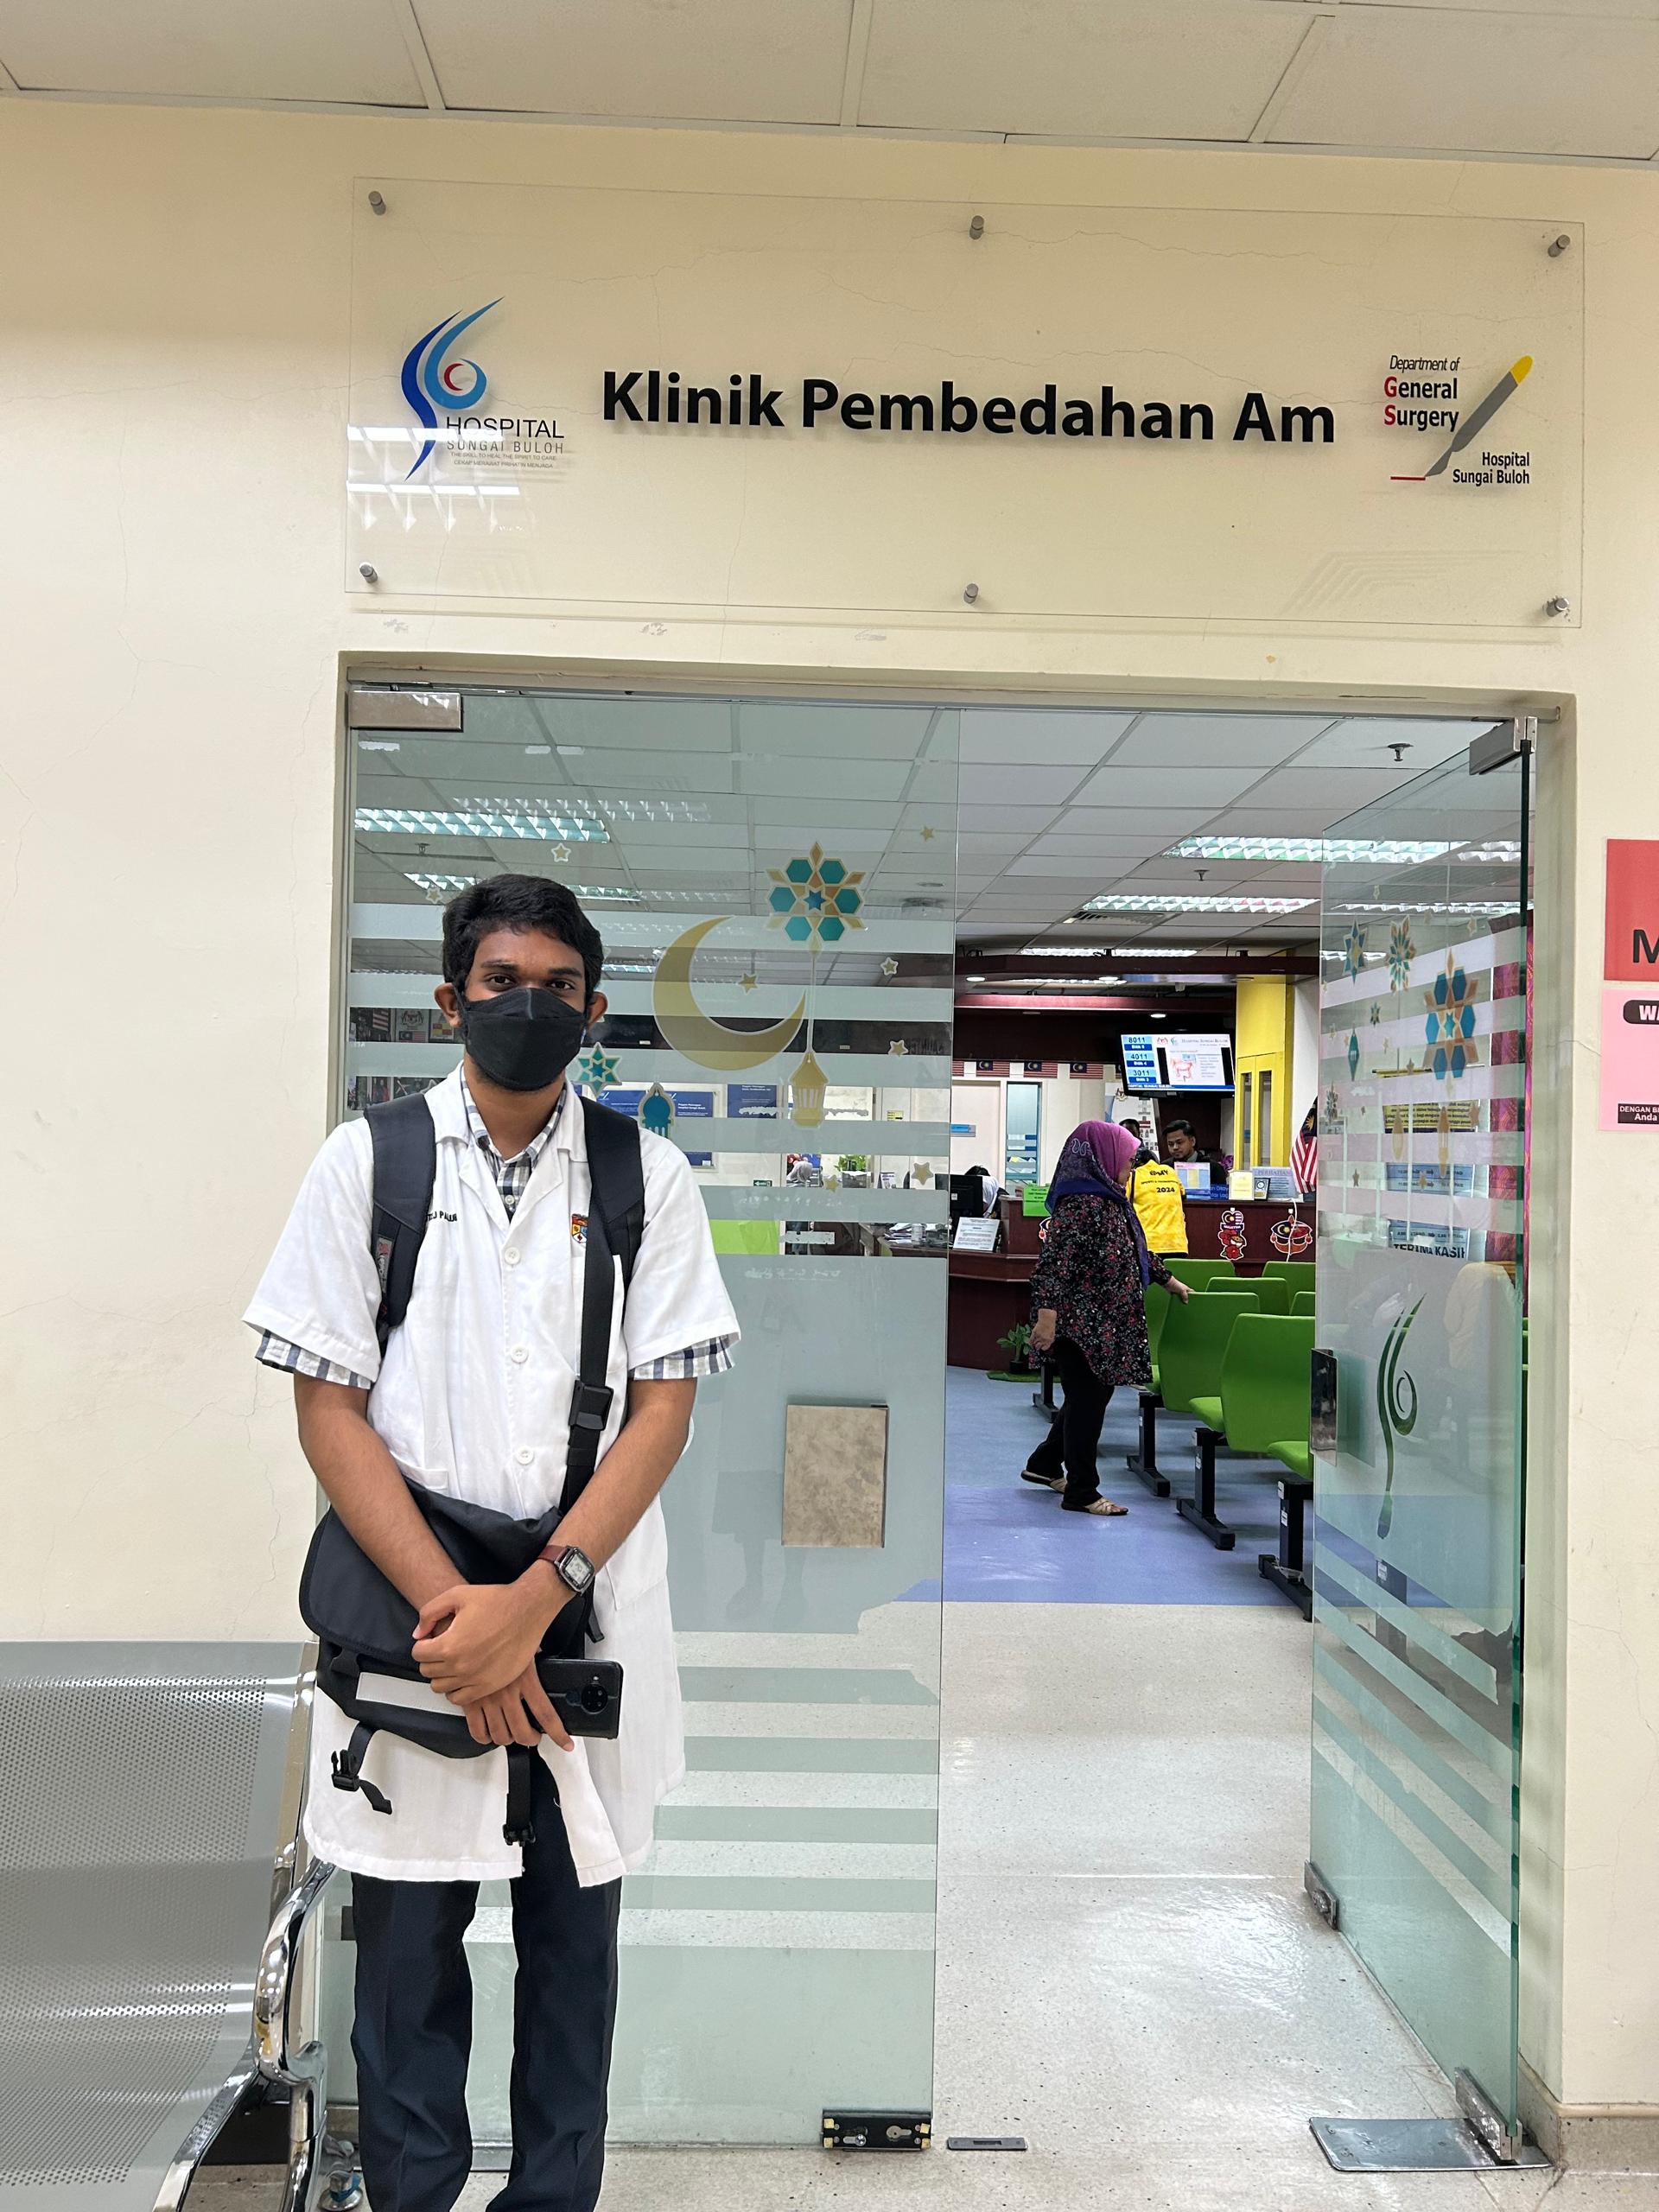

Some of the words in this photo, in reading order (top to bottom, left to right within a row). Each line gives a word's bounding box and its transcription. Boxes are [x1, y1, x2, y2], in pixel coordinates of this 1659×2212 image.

[1389, 355, 1447, 373] Department
[1450, 357, 1460, 371] of
[1384, 376, 1458, 399] General
[604, 371, 785, 427] Klinik
[804, 378, 1213, 440] Pembedahan
[1233, 392, 1334, 443] Am
[1384, 404, 1459, 432] Surgery
[446, 416, 564, 439] HOSPITAL
[447, 440, 505, 452] SUNGAI
[513, 441, 563, 454] BULOH
[1482, 452, 1529, 469] Hospital
[1452, 469, 1493, 486] Sungai
[1497, 470, 1529, 484] Buloh
[1639, 1005, 1659, 1021] W
[1635, 1113, 1657, 1122] Anda
